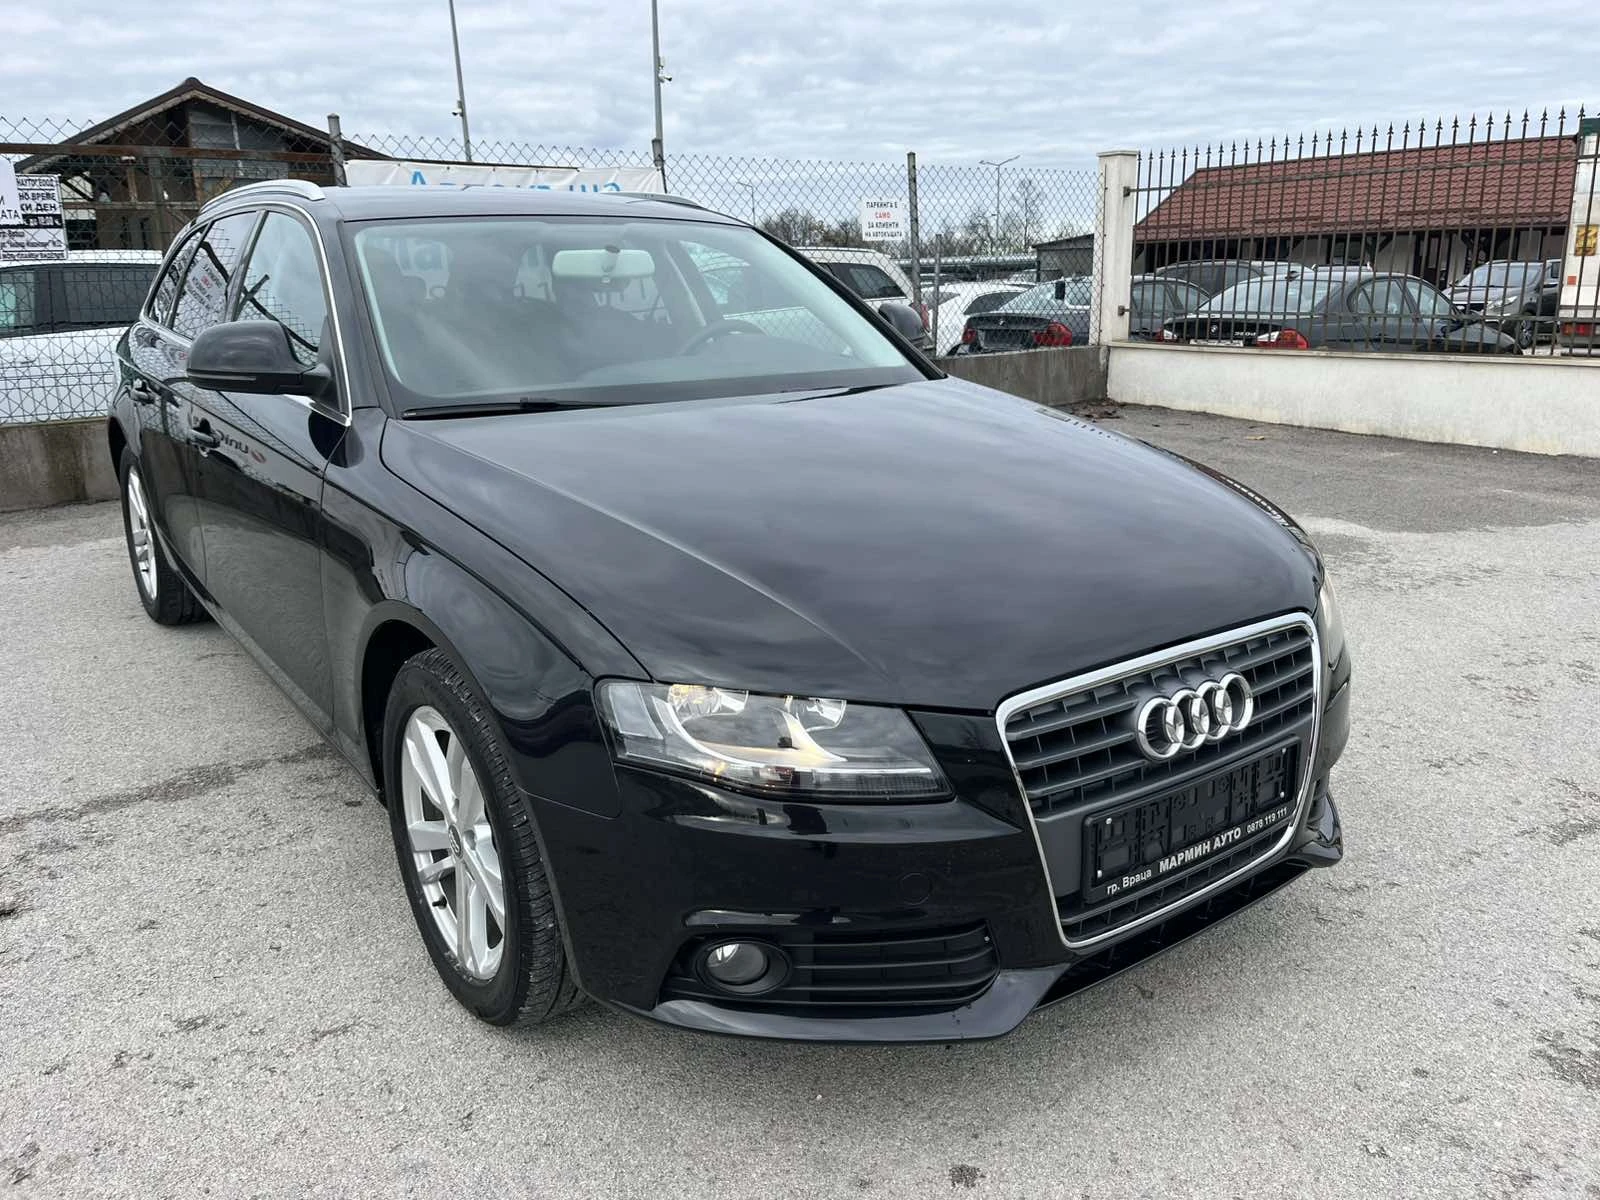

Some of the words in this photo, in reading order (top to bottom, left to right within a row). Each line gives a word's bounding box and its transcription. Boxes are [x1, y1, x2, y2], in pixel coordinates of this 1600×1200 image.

[35, 203, 57, 212] ДЕН
[1107, 884, 1120, 896] гр.
[1122, 868, 1152, 889] Враца
[1159, 841, 1211, 873] МАРМИН
[1213, 827, 1242, 850] АУТО
[1264, 812, 1276, 825] 119
[1276, 807, 1288, 820] 111
